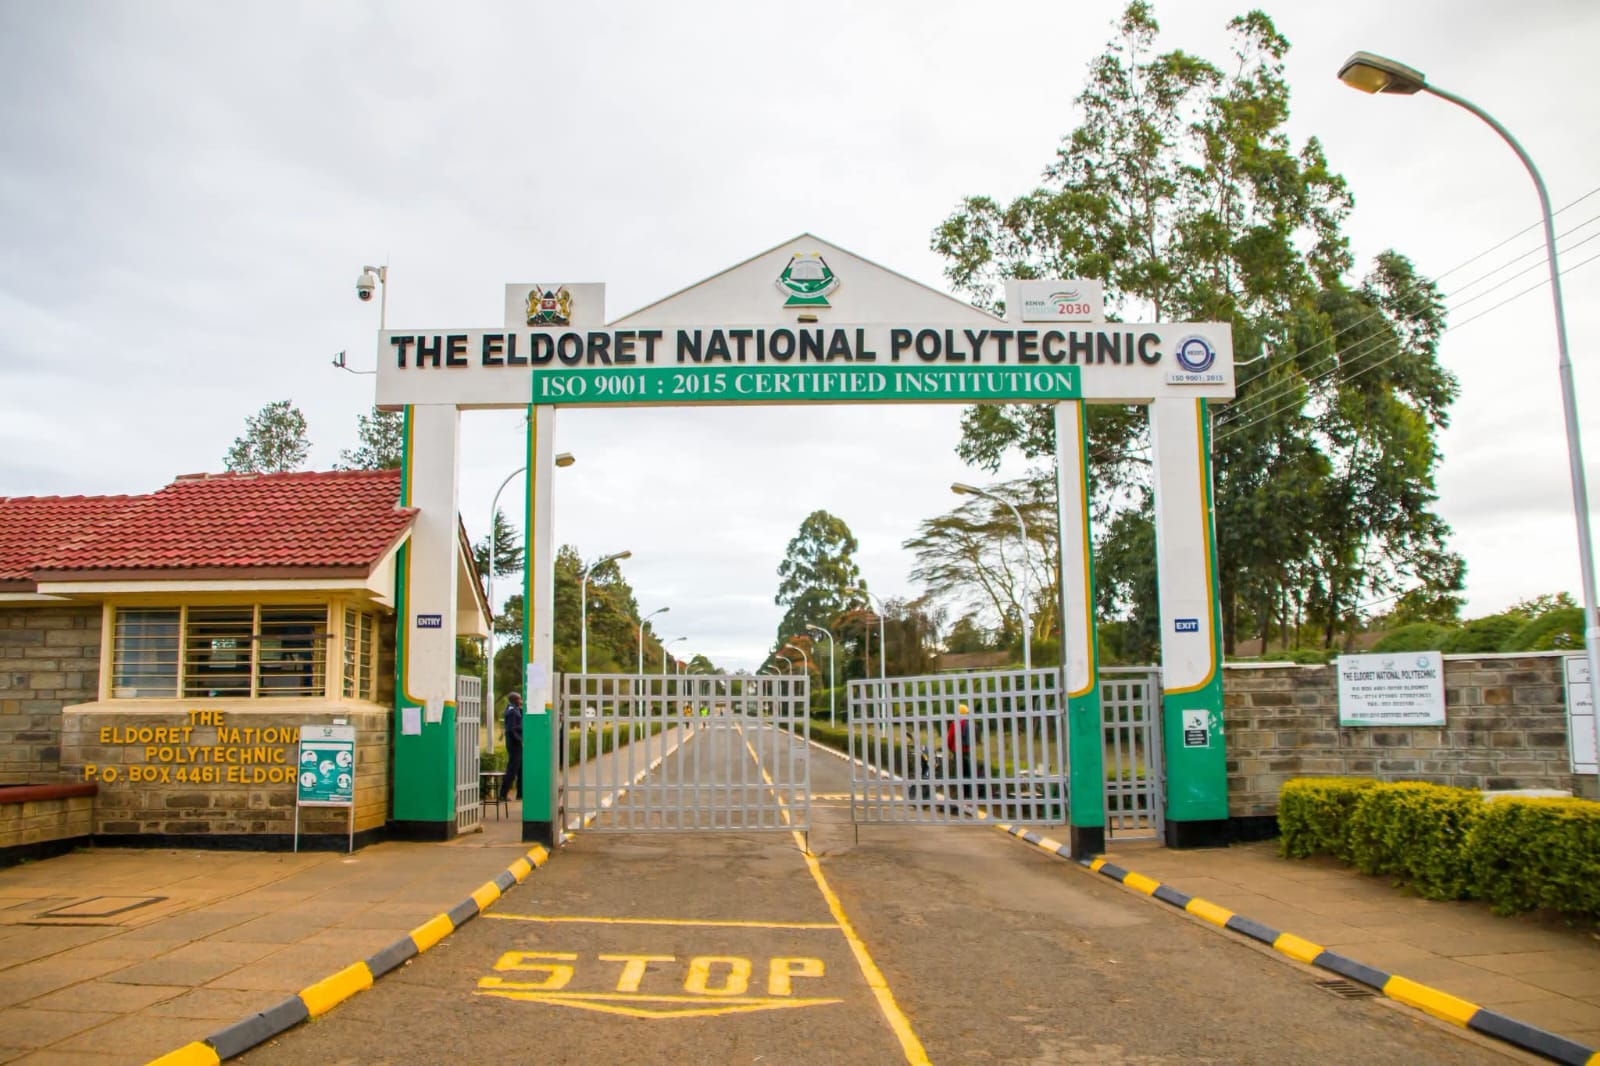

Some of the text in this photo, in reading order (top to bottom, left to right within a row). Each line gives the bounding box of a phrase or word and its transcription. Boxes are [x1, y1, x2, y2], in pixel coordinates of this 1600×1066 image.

[1058, 303, 1090, 314] 2030
[390, 334, 468, 369] THE
[482, 330, 663, 367] ELDORET
[676, 328, 877, 363] NATIONAL
[890, 329, 1163, 365] POLYTECHNIC
[541, 375, 587, 396] ISO
[594, 374, 647, 395] 9001
[672, 373, 727, 394] 2015
[734, 372, 887, 393] CERTIFIED
[895, 372, 1073, 393] INSTITUTION
[418, 618, 440, 626] ENTRY
[1376, 671, 1400, 680] NATIONAL
[188, 709, 225, 726] THE
[100, 725, 300, 745] ELDORET NATIONA
[145, 745, 286, 764] POLYTECHNIC
[128, 765, 171, 784] BOX
[175, 766, 220, 784] 4461
[227, 765, 297, 784] ELDOR
[477, 951, 826, 996] STOP
